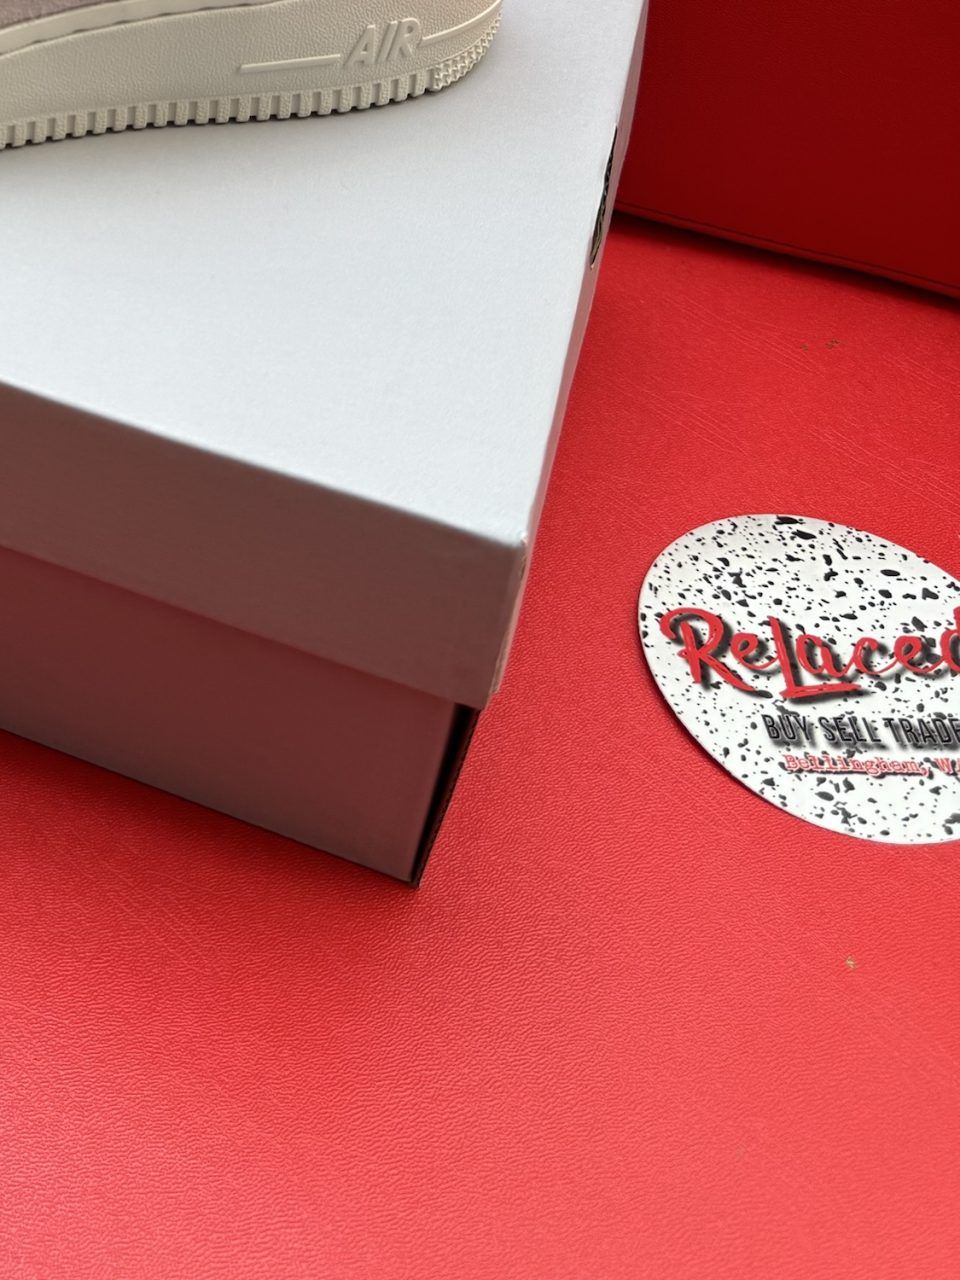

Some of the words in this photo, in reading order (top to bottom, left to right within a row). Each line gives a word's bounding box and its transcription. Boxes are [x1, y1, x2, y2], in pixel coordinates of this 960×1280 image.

[344, 18, 421, 66] AIR
[761, 714, 812, 741] BUY
[818, 716, 882, 743] SELL
[934, 757, 960, 776] W
